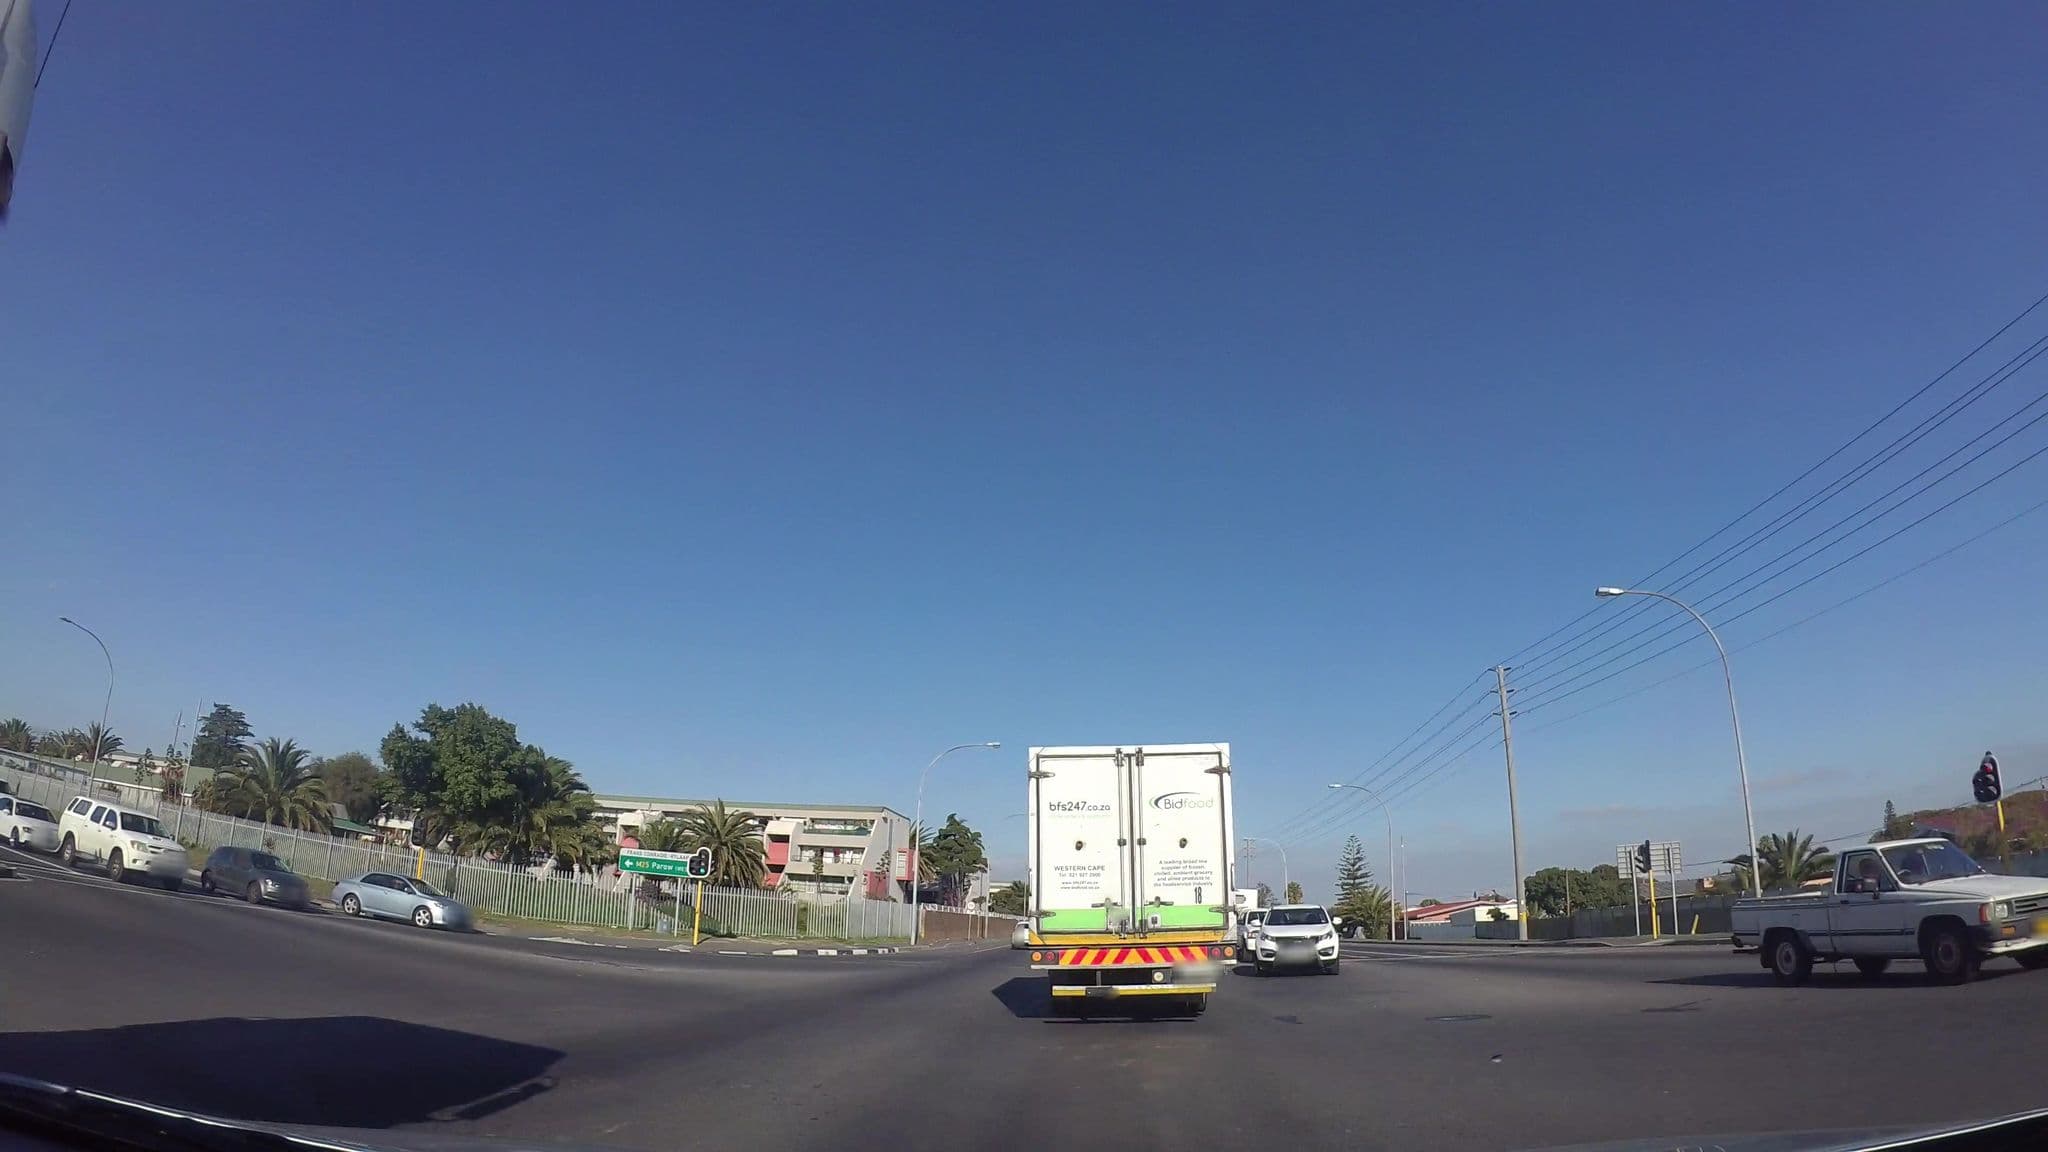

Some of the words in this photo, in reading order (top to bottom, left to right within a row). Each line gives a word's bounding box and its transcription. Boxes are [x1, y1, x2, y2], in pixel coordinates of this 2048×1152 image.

[1049, 801, 1111, 811] bfs247.co.za
[1164, 798, 1214, 809] Bidfood
[651, 862, 673, 870] Parow
[1194, 886, 1203, 905] 18
